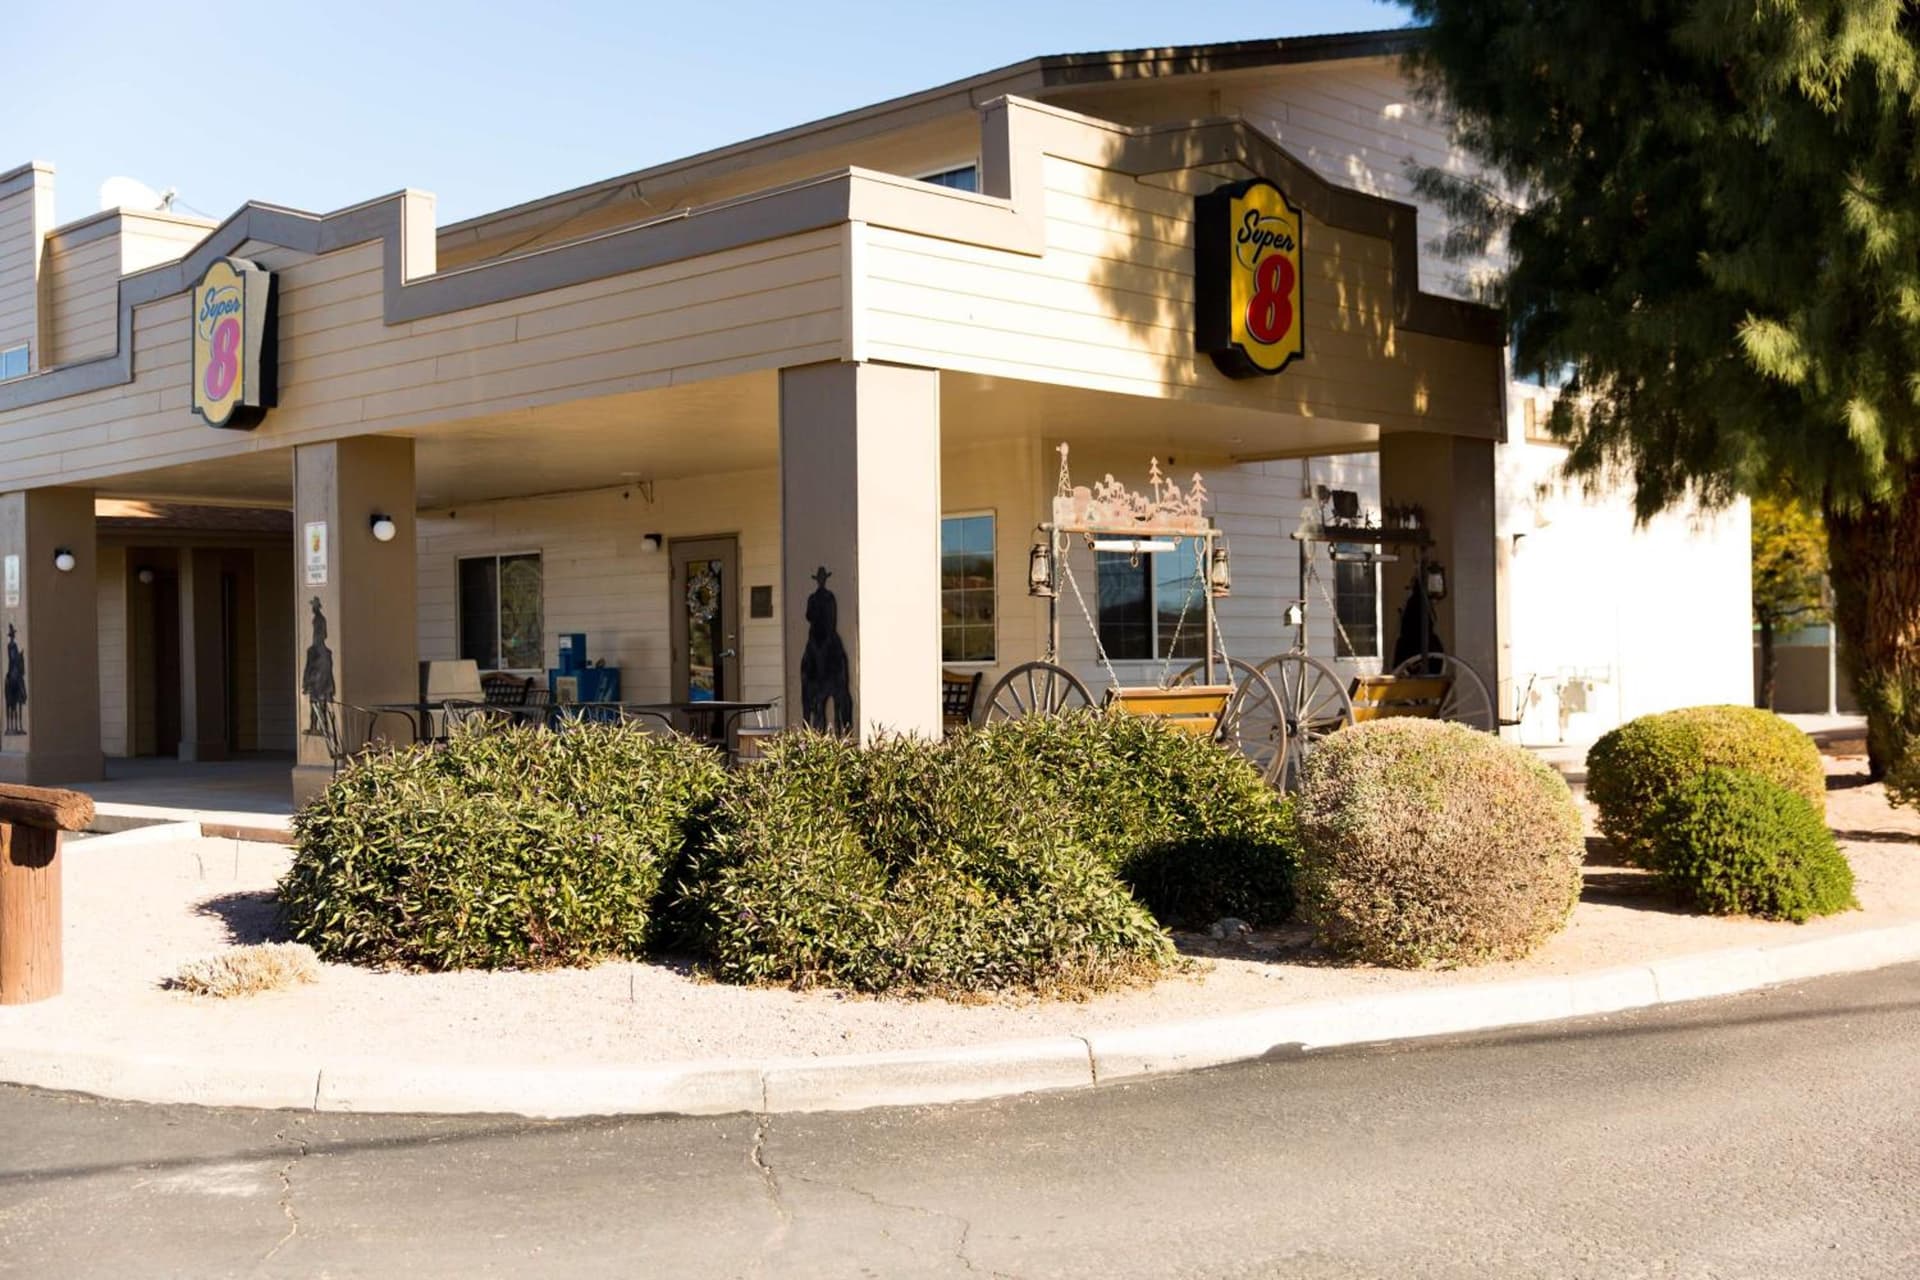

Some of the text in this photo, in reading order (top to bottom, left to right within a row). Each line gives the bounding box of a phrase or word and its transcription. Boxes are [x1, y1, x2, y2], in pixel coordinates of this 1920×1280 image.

[1237, 209, 1295, 264] Super
[200, 287, 240, 336] Super
[1246, 254, 1295, 345] 8
[204, 317, 240, 401] 8
